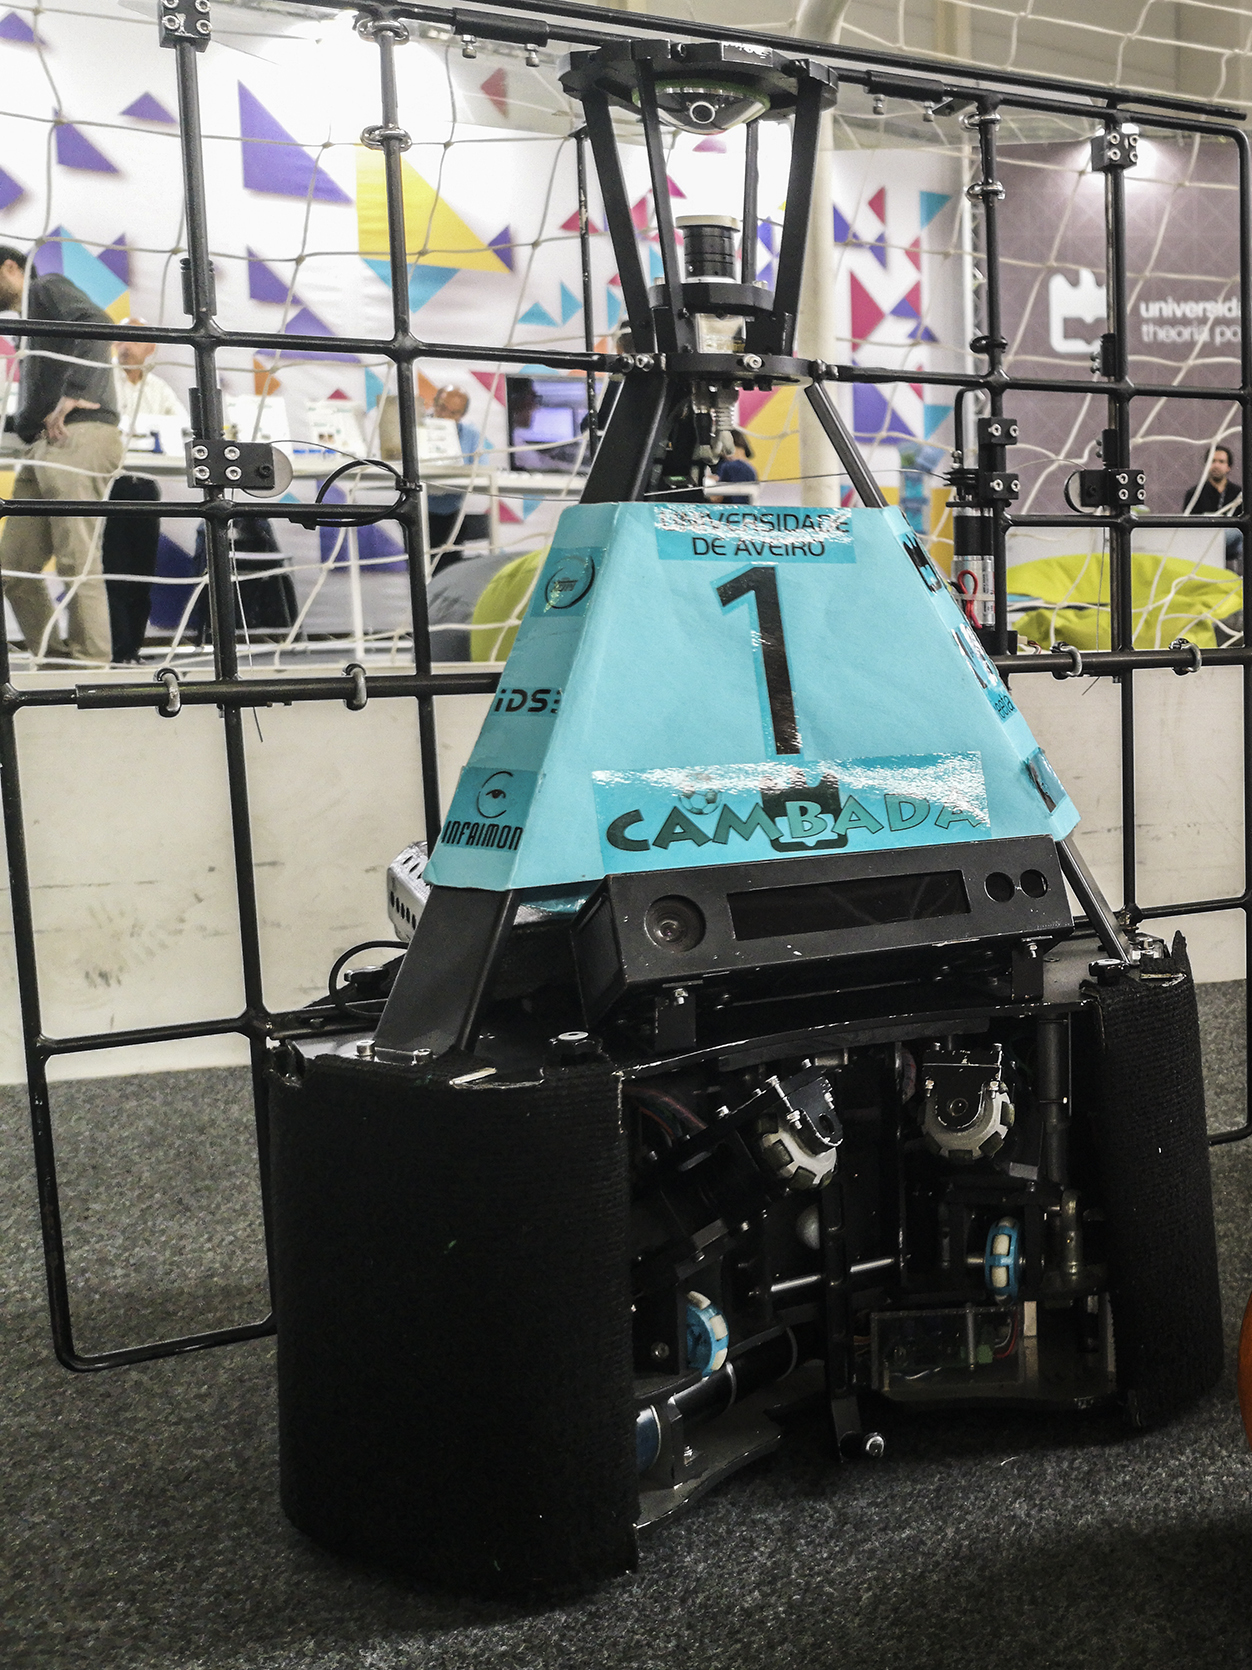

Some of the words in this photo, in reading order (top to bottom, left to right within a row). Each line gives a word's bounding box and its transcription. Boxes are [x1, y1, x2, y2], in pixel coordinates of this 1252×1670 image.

[692, 537, 726, 556] DE
[734, 538, 826, 557] AVEIRO
[716, 566, 801, 755] 1
[441, 820, 524, 851] INFAIMON
[606, 793, 988, 853] CAMBADA
